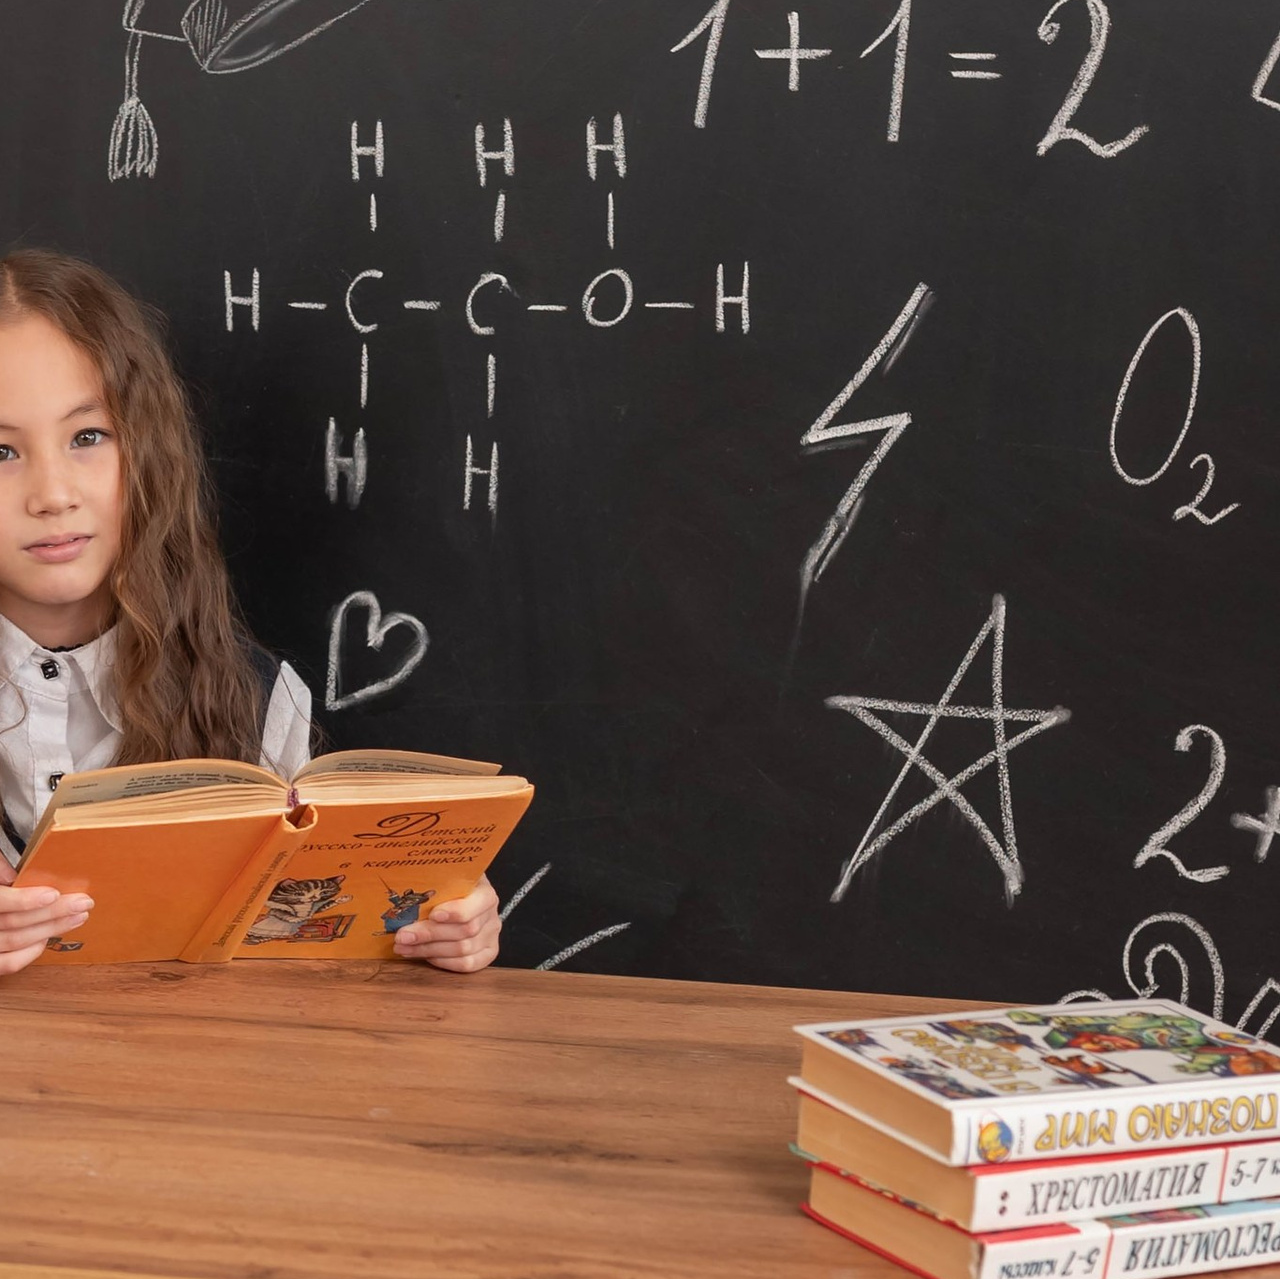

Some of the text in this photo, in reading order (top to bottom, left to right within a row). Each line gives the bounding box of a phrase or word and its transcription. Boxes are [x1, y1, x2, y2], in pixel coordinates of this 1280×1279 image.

[354, 808, 497, 840] Детский
[339, 853, 477, 870] в картинках
[407, 844, 483, 858] словарь
[1034, 1108, 1117, 1152] МИР
[1127, 1093, 1279, 1142] ПОЗНАЮ
[1026, 1161, 1209, 1216] ХРЕСТОМАТИЯ
[1231, 1158, 1268, 1187] 5-7
[998, 1257, 1057, 1279] классы
[1061, 1247, 1101, 1277] 5-7
